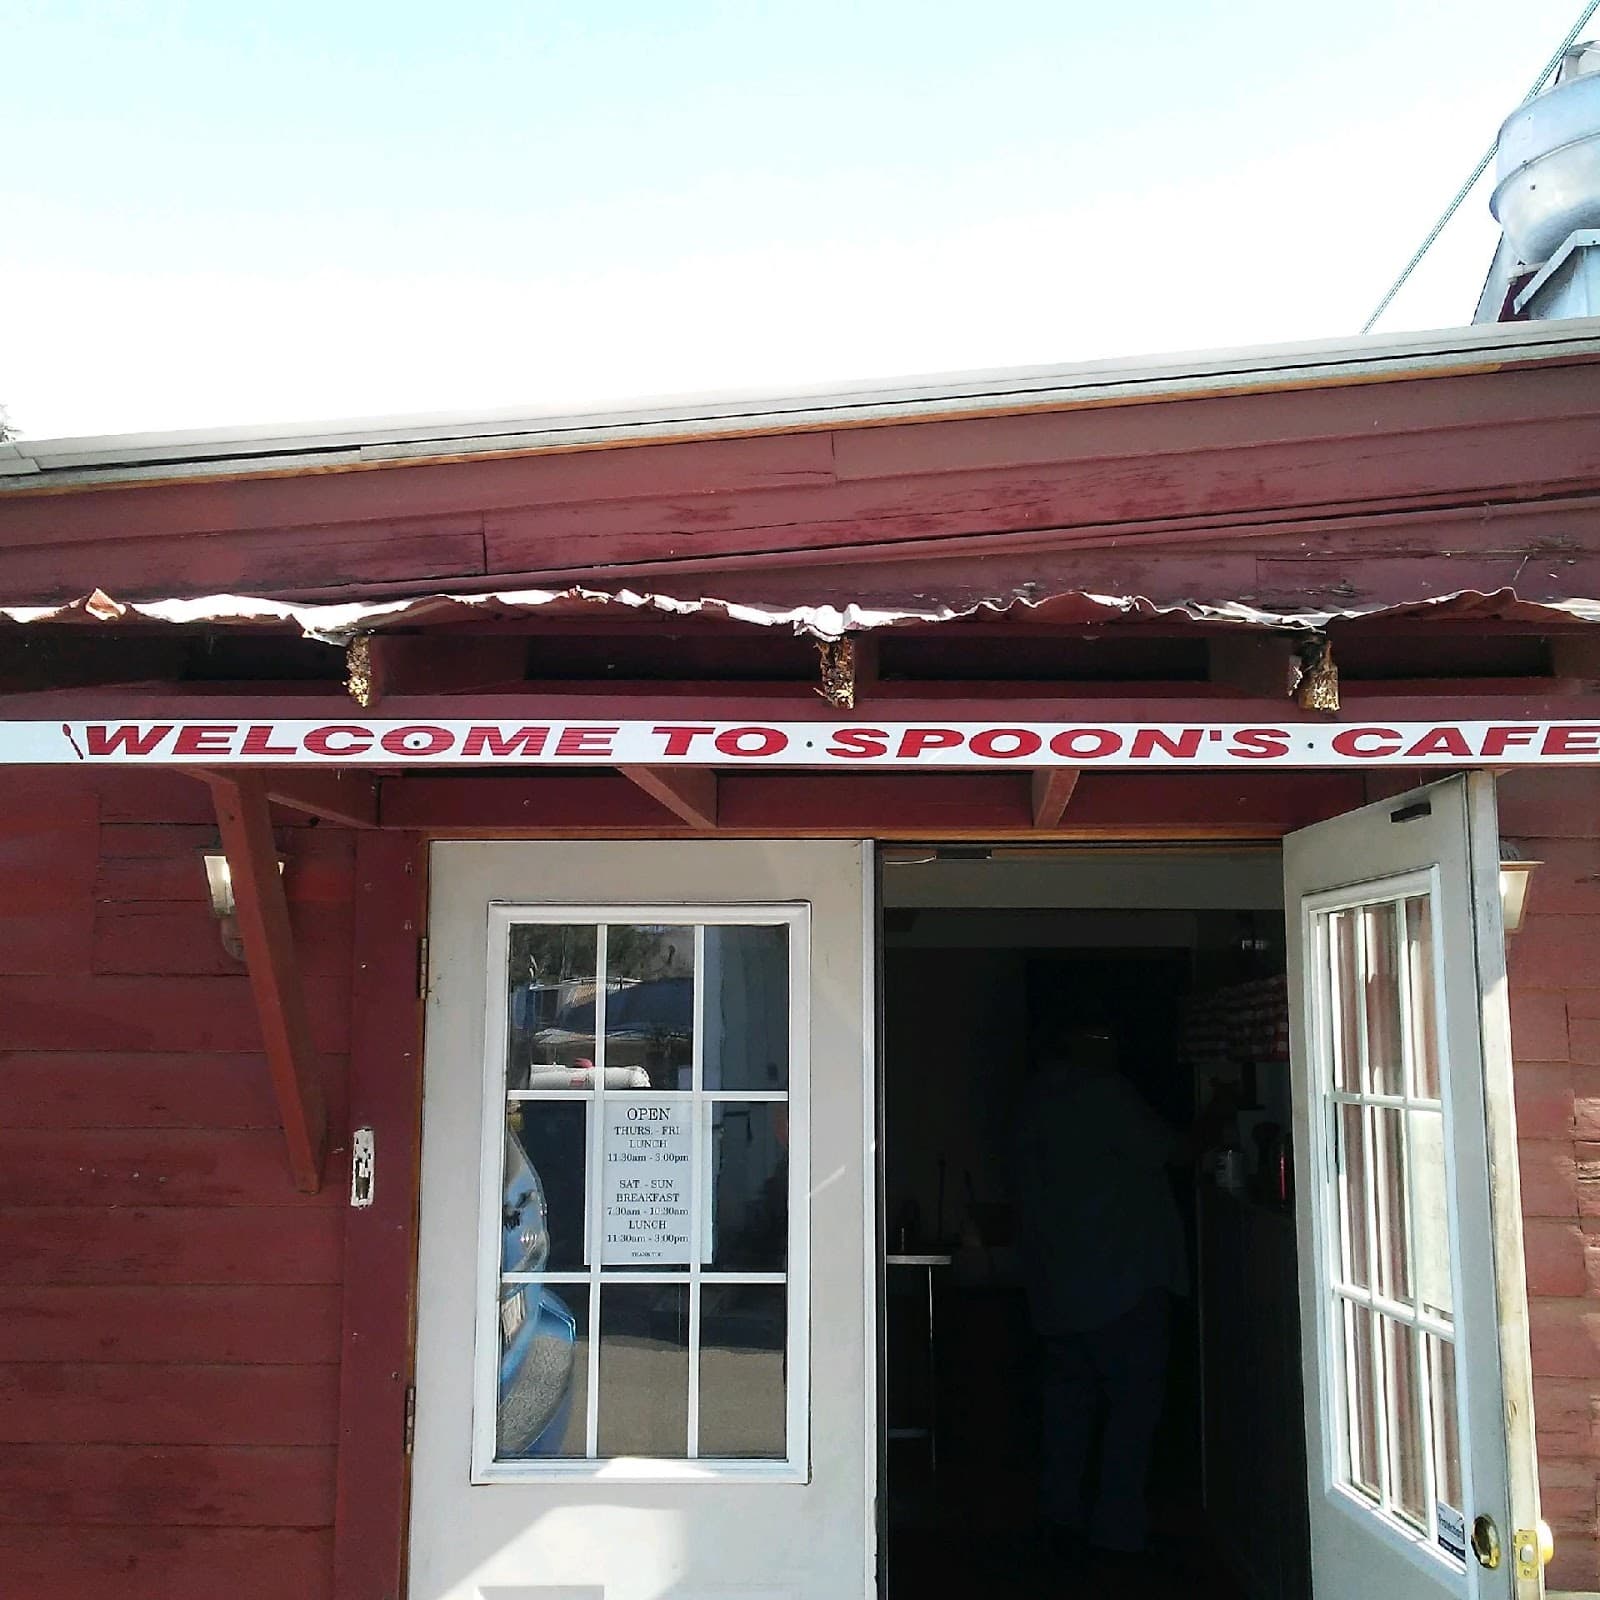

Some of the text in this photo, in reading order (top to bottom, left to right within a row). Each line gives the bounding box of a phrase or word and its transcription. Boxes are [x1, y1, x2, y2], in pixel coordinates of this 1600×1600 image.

[86, 725, 1600, 759] WELCOME TO SPOON'S CAFE
[627, 1107, 671, 1121] OPEN
[661, 1125, 680, 1136] FRI
[629, 1139, 667, 1148] LUNCH
[650, 1179, 674, 1189] SUN
[616, 1193, 680, 1203] BREAKFAST
[628, 1220, 667, 1230] LUNCH
